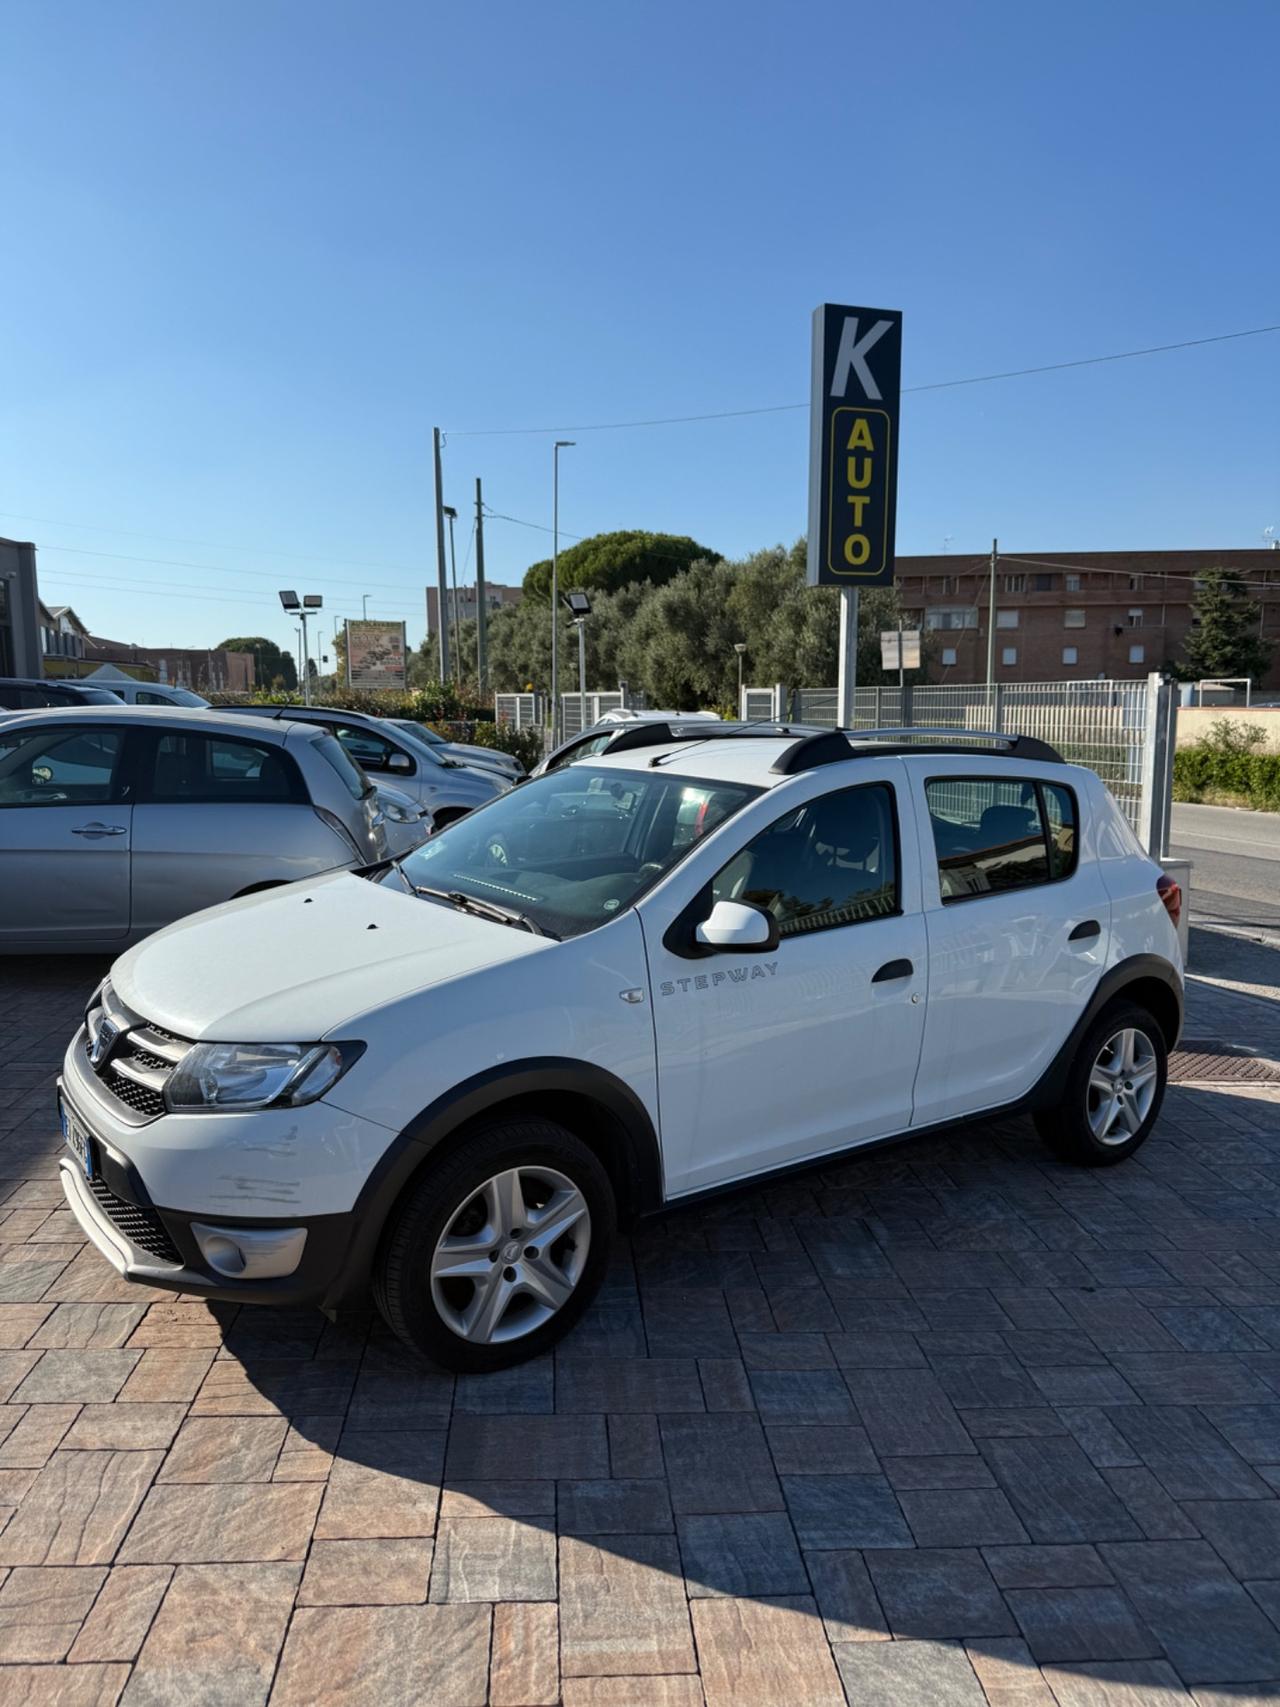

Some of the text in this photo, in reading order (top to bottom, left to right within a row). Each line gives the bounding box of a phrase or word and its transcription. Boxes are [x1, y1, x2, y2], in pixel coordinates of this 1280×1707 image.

[830, 316, 894, 400] K
[844, 418, 874, 565] AUTO
[660, 962, 778, 996] STEPWAY
